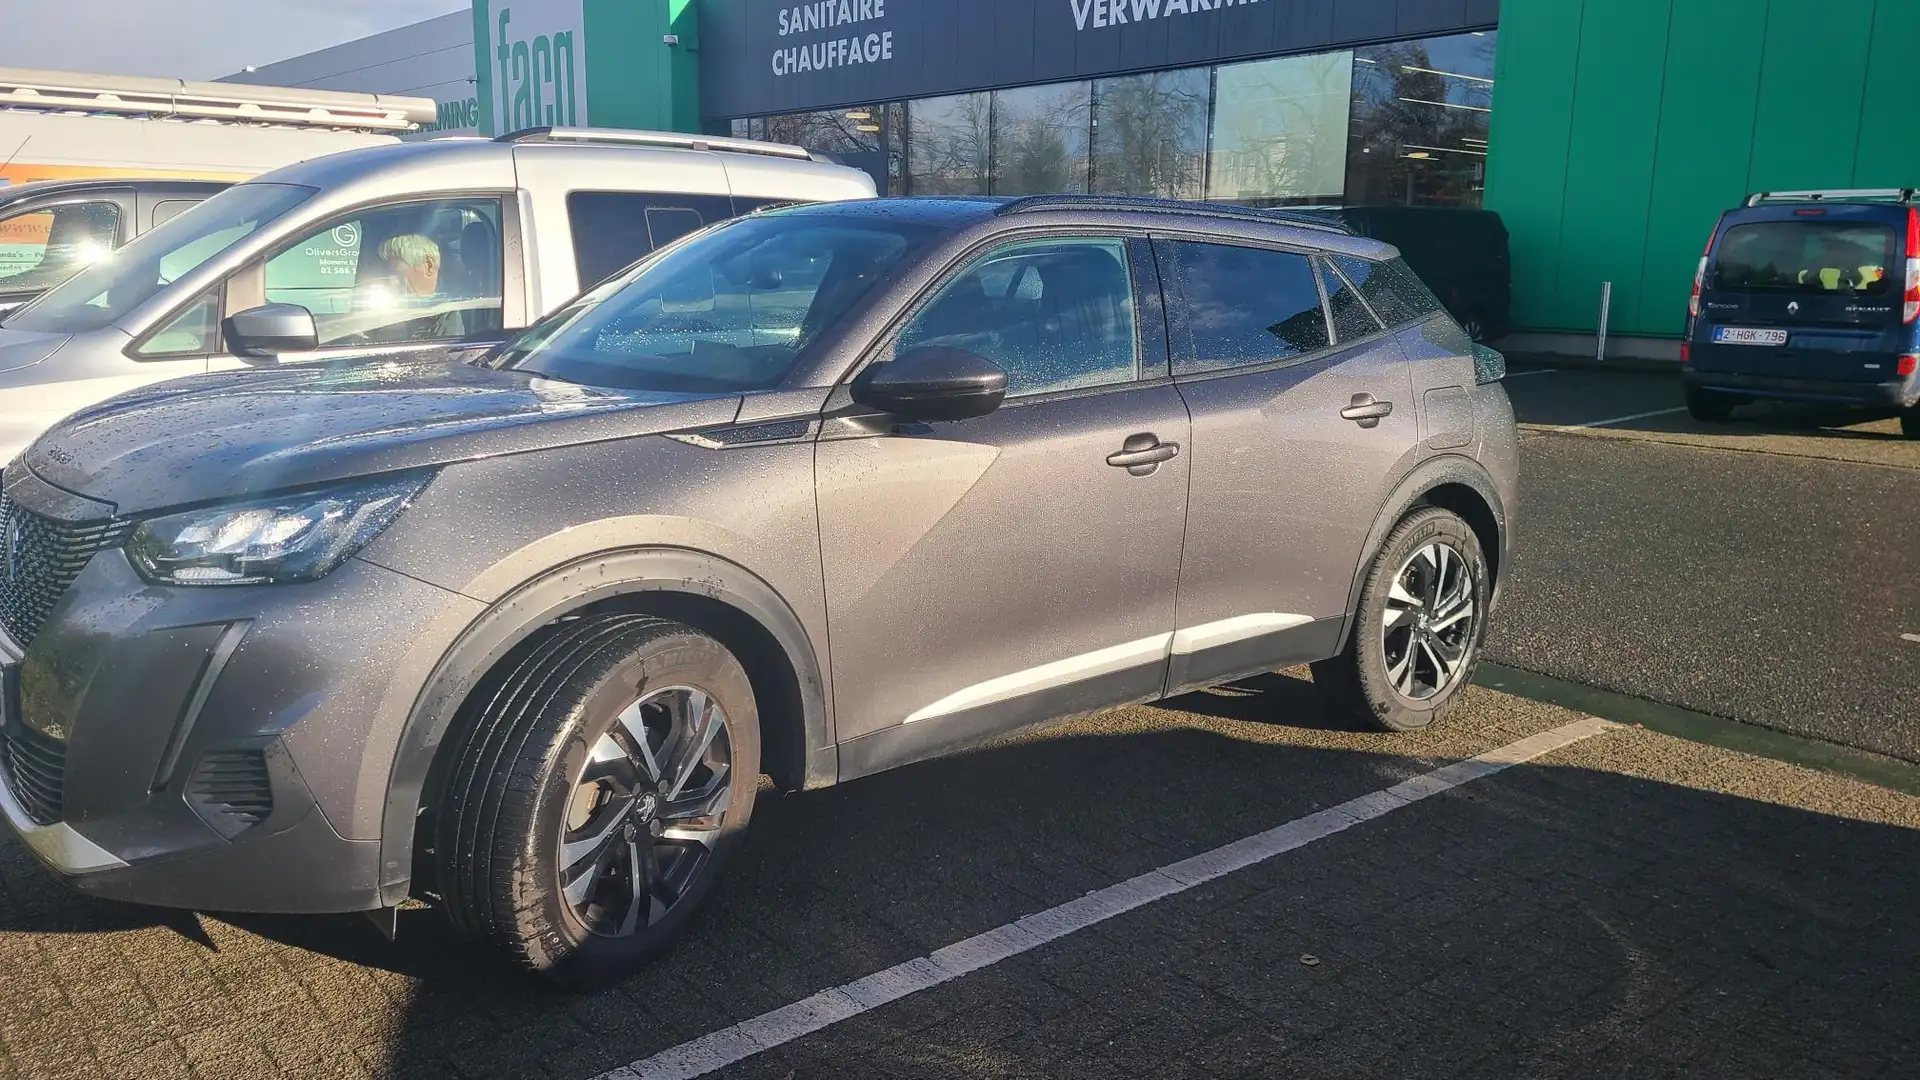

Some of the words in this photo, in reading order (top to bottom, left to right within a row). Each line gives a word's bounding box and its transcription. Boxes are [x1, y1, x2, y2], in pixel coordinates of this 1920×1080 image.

[778, 0, 885, 36] SANITAIRE
[1070, 0, 1268, 31] VERWA
[772, 31, 892, 75] CHAUFFAGE
